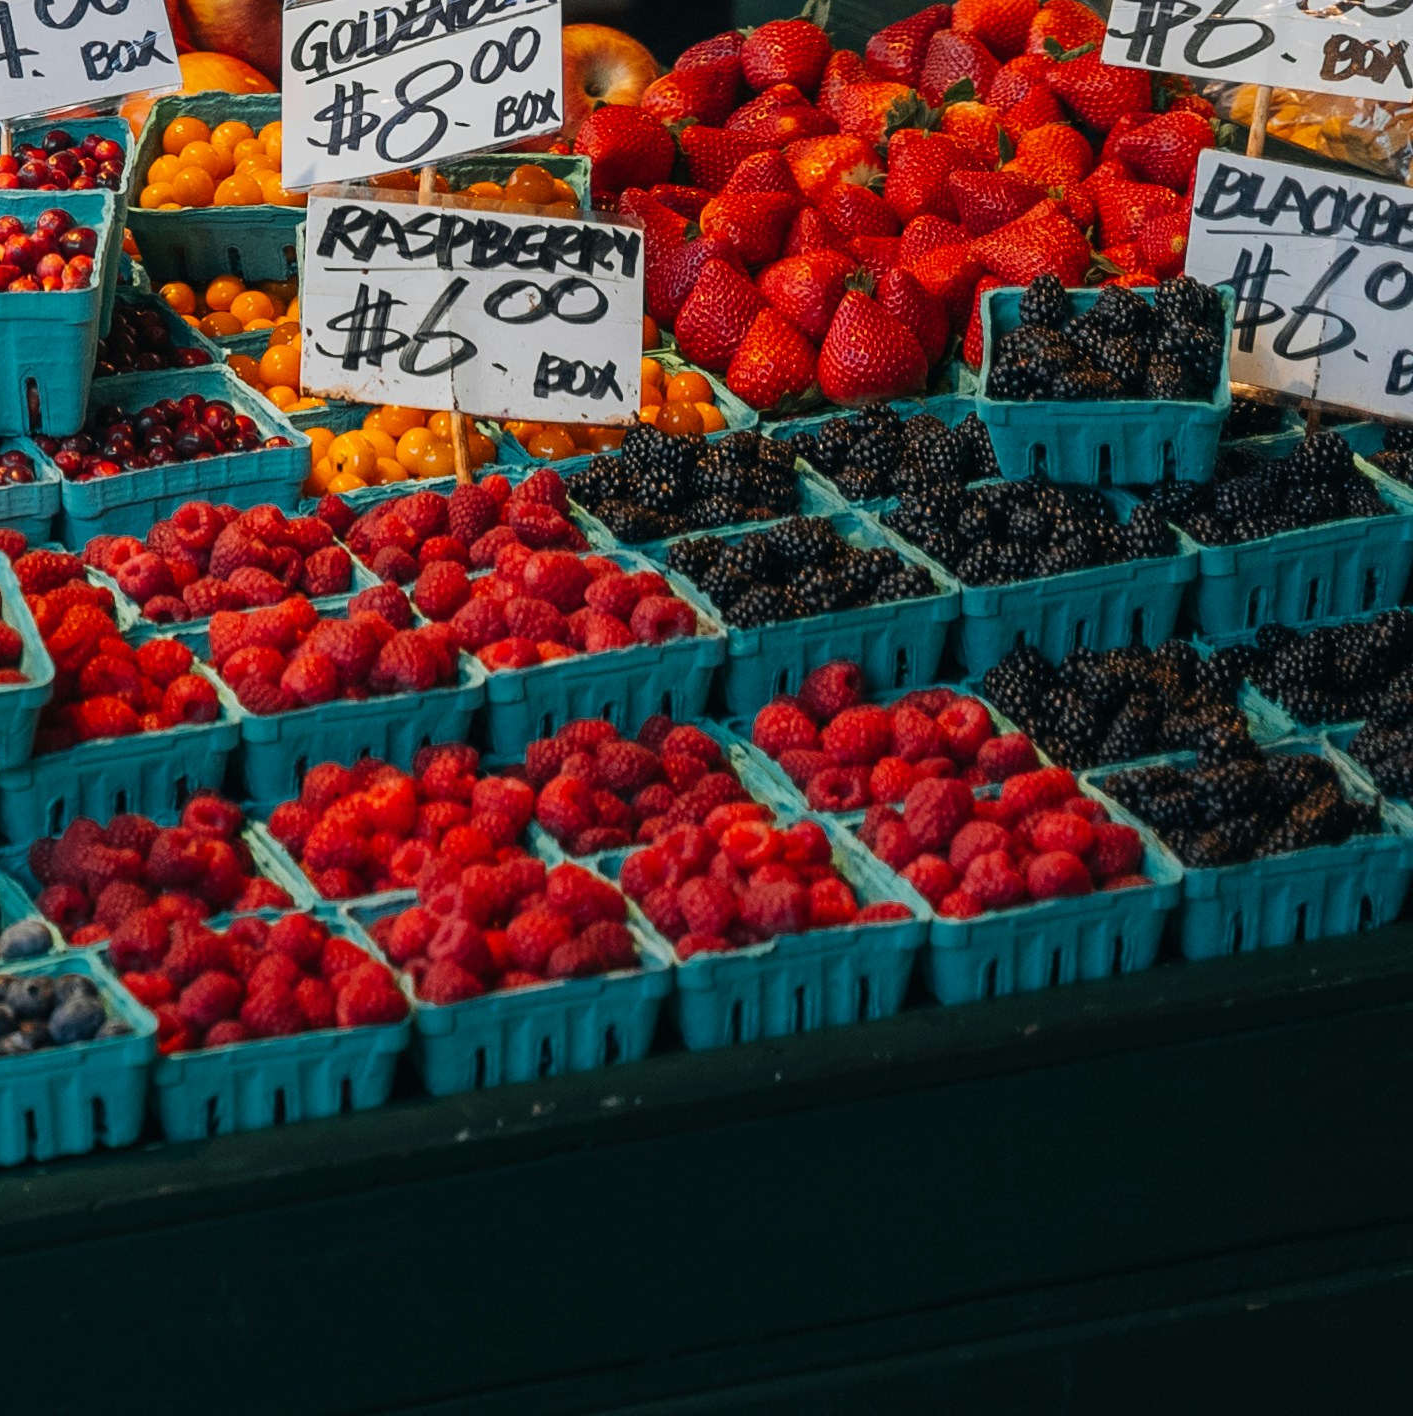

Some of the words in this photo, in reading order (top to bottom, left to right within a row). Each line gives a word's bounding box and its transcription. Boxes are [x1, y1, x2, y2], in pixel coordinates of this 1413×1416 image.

[81, 30, 175, 81] BOX
[1320, 34, 1413, 89] BOX
[494, 89, 562, 138] BOX
[316, 205, 641, 278] RASPBERRY
[534, 351, 624, 402] BOX
